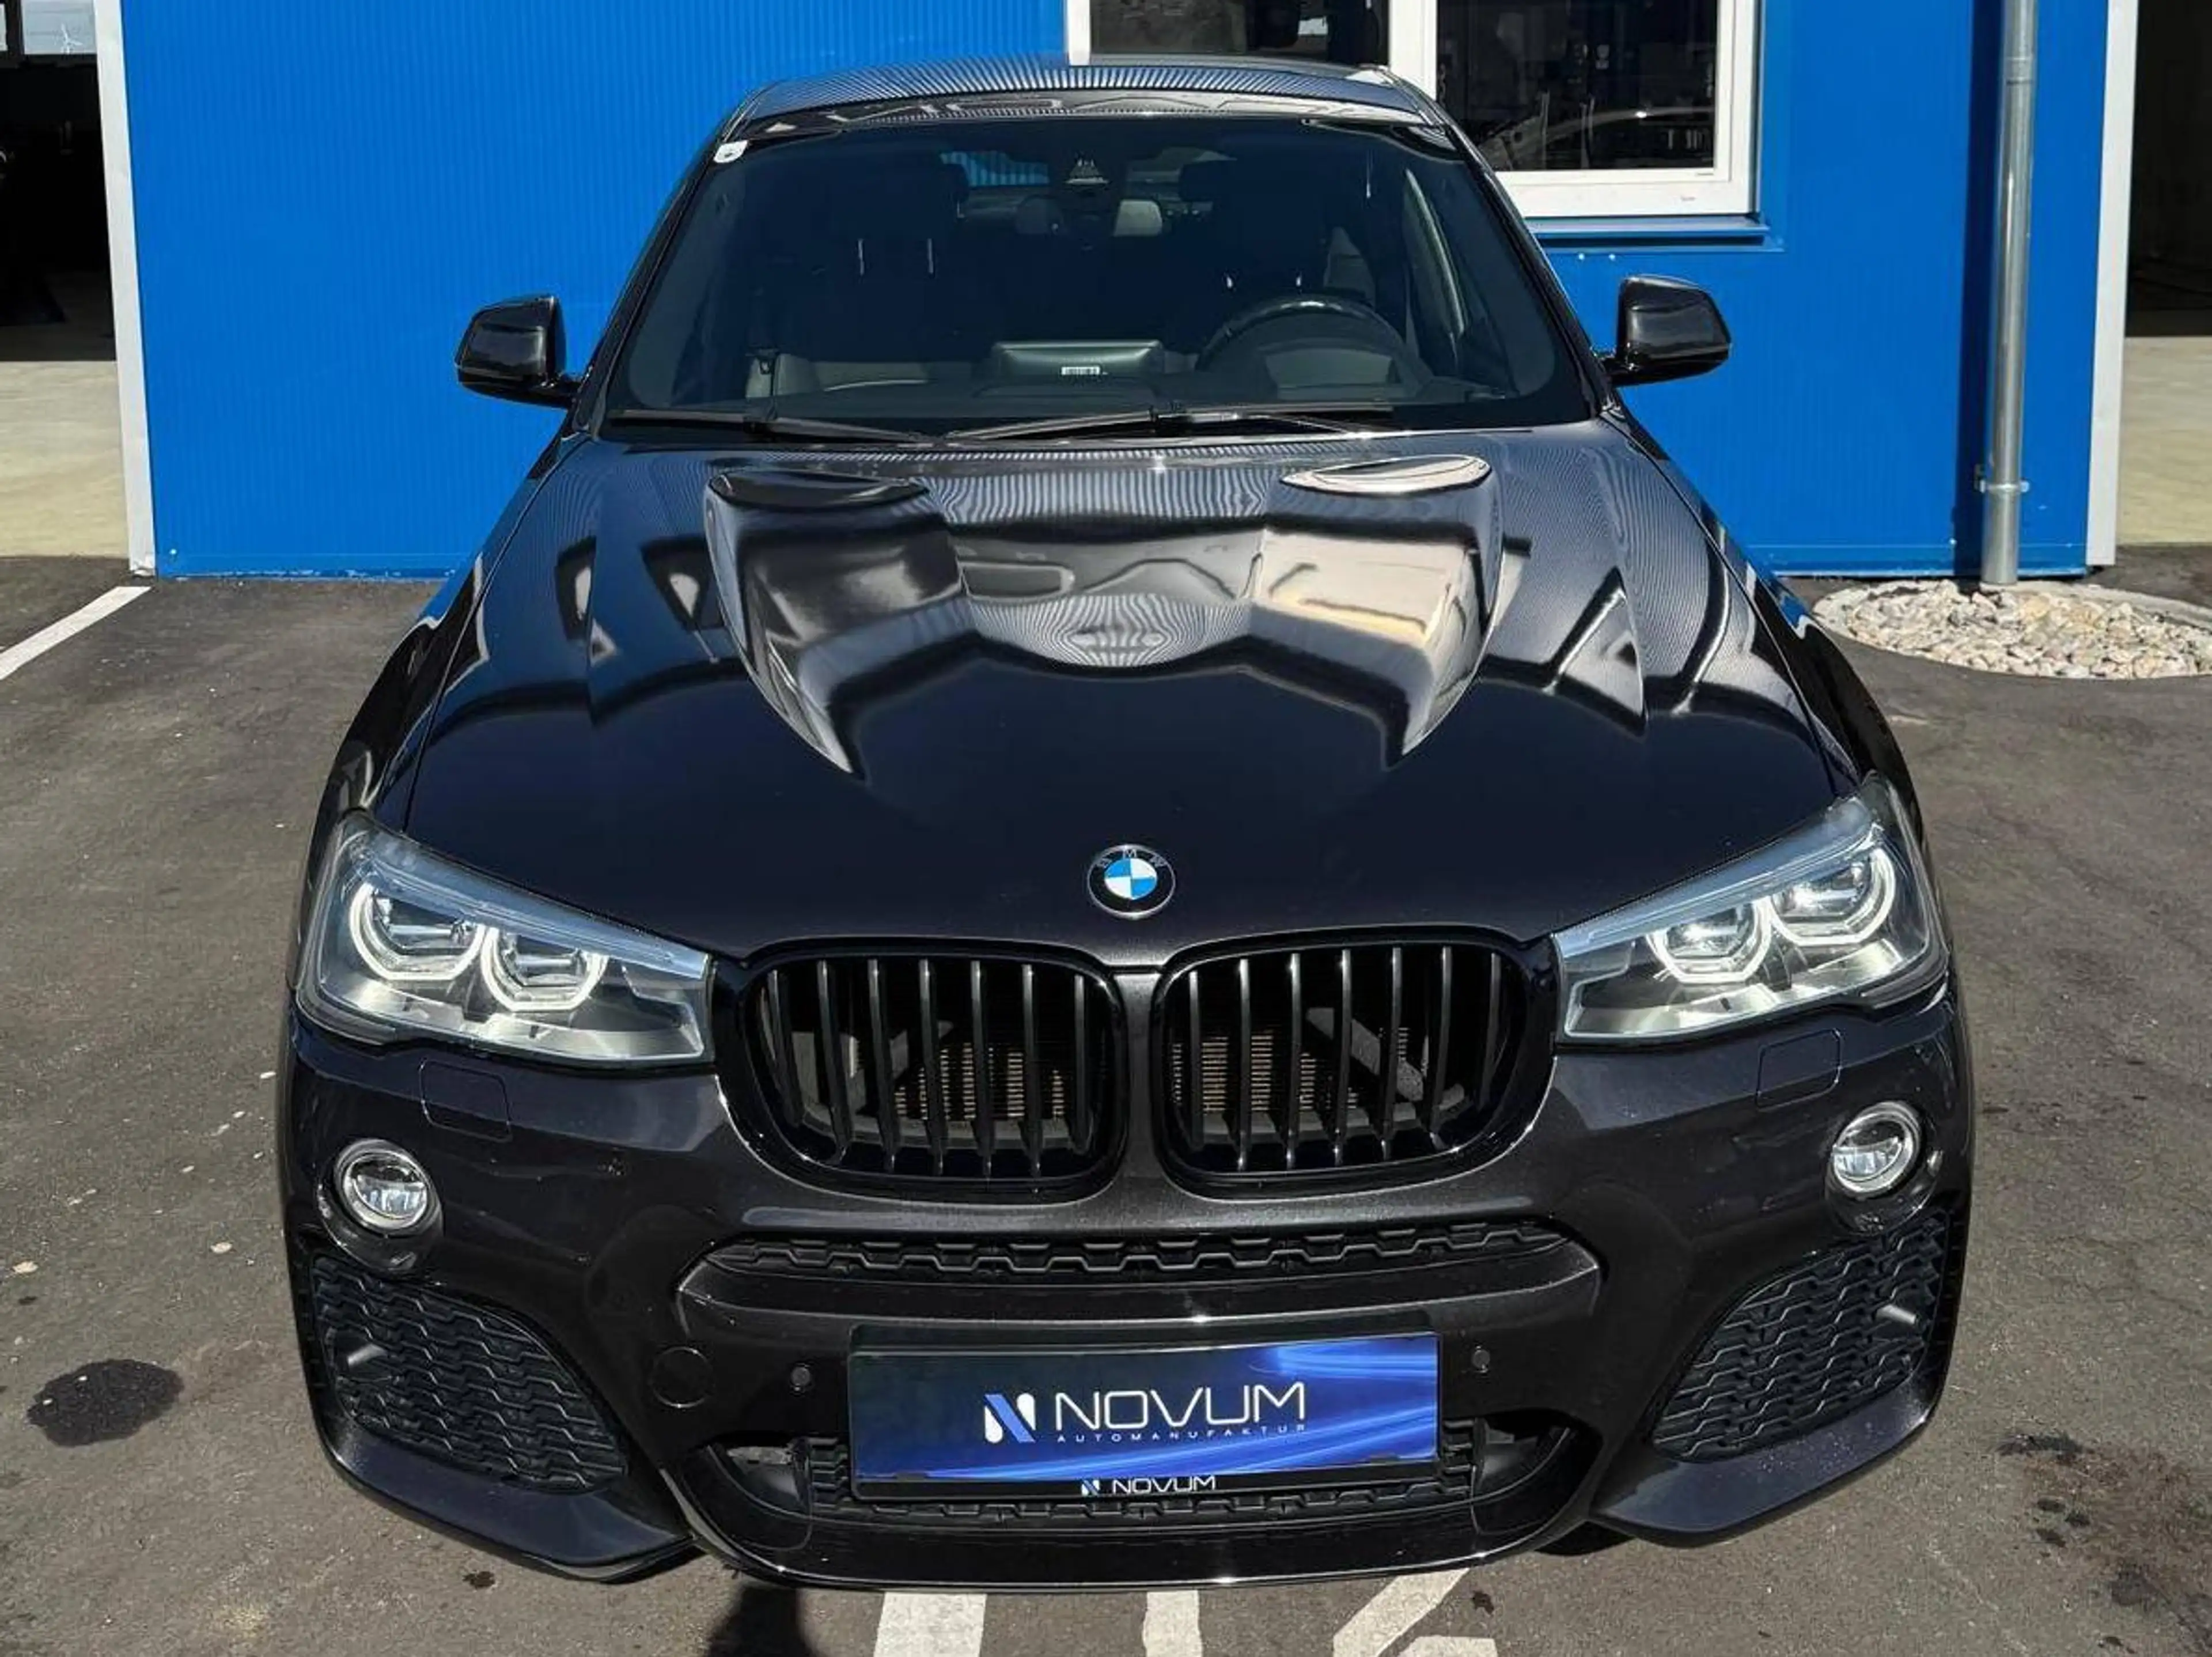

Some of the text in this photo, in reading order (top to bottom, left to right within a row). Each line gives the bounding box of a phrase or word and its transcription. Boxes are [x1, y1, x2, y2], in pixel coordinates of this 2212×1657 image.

[1096, 848, 1169, 869] BMW
[1055, 1381, 1305, 1431] NOVUM
[1056, 1424, 1305, 1443] AUTOMANUFAKTUR
[1112, 1475, 1215, 1495] NOVUM
